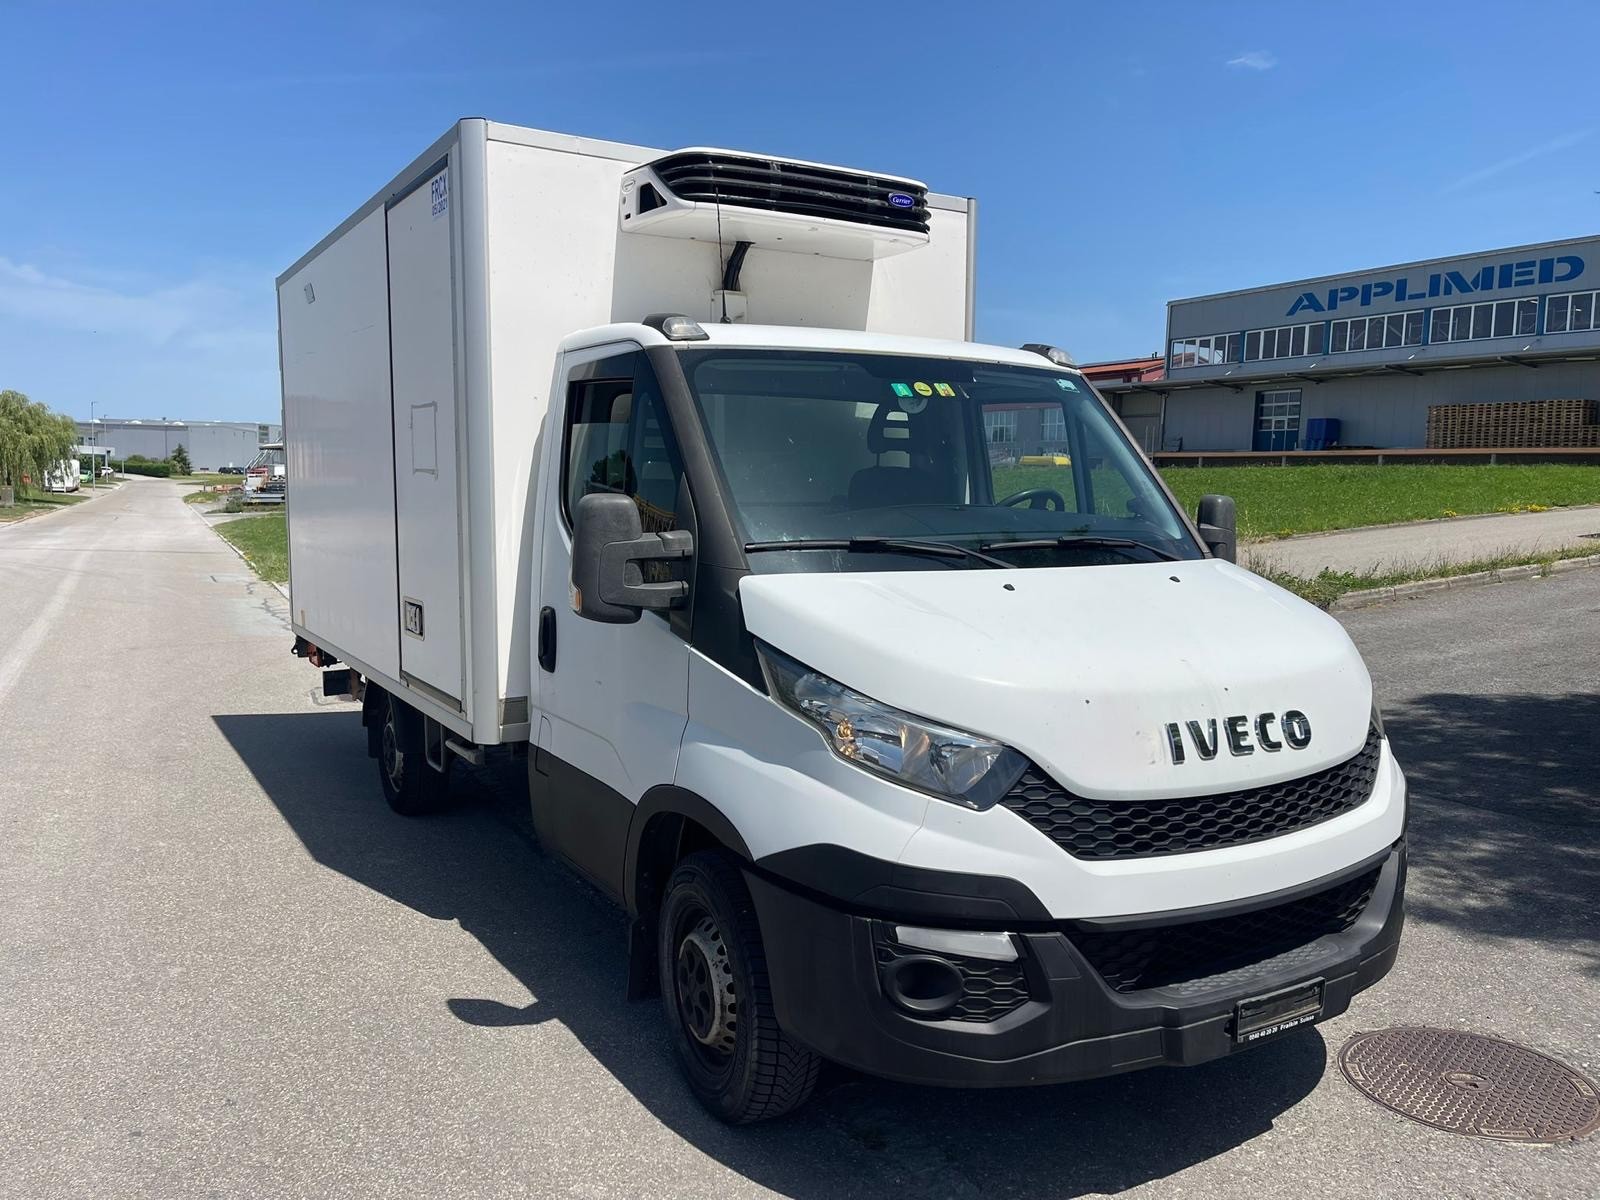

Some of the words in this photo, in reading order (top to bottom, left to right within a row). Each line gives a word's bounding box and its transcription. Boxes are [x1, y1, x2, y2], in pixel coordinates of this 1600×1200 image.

[431, 173, 448, 204] FRCX
[892, 196, 911, 205] Carrier
[1285, 255, 1585, 317] APPLIMED
[1165, 709, 1312, 765] IVECO
